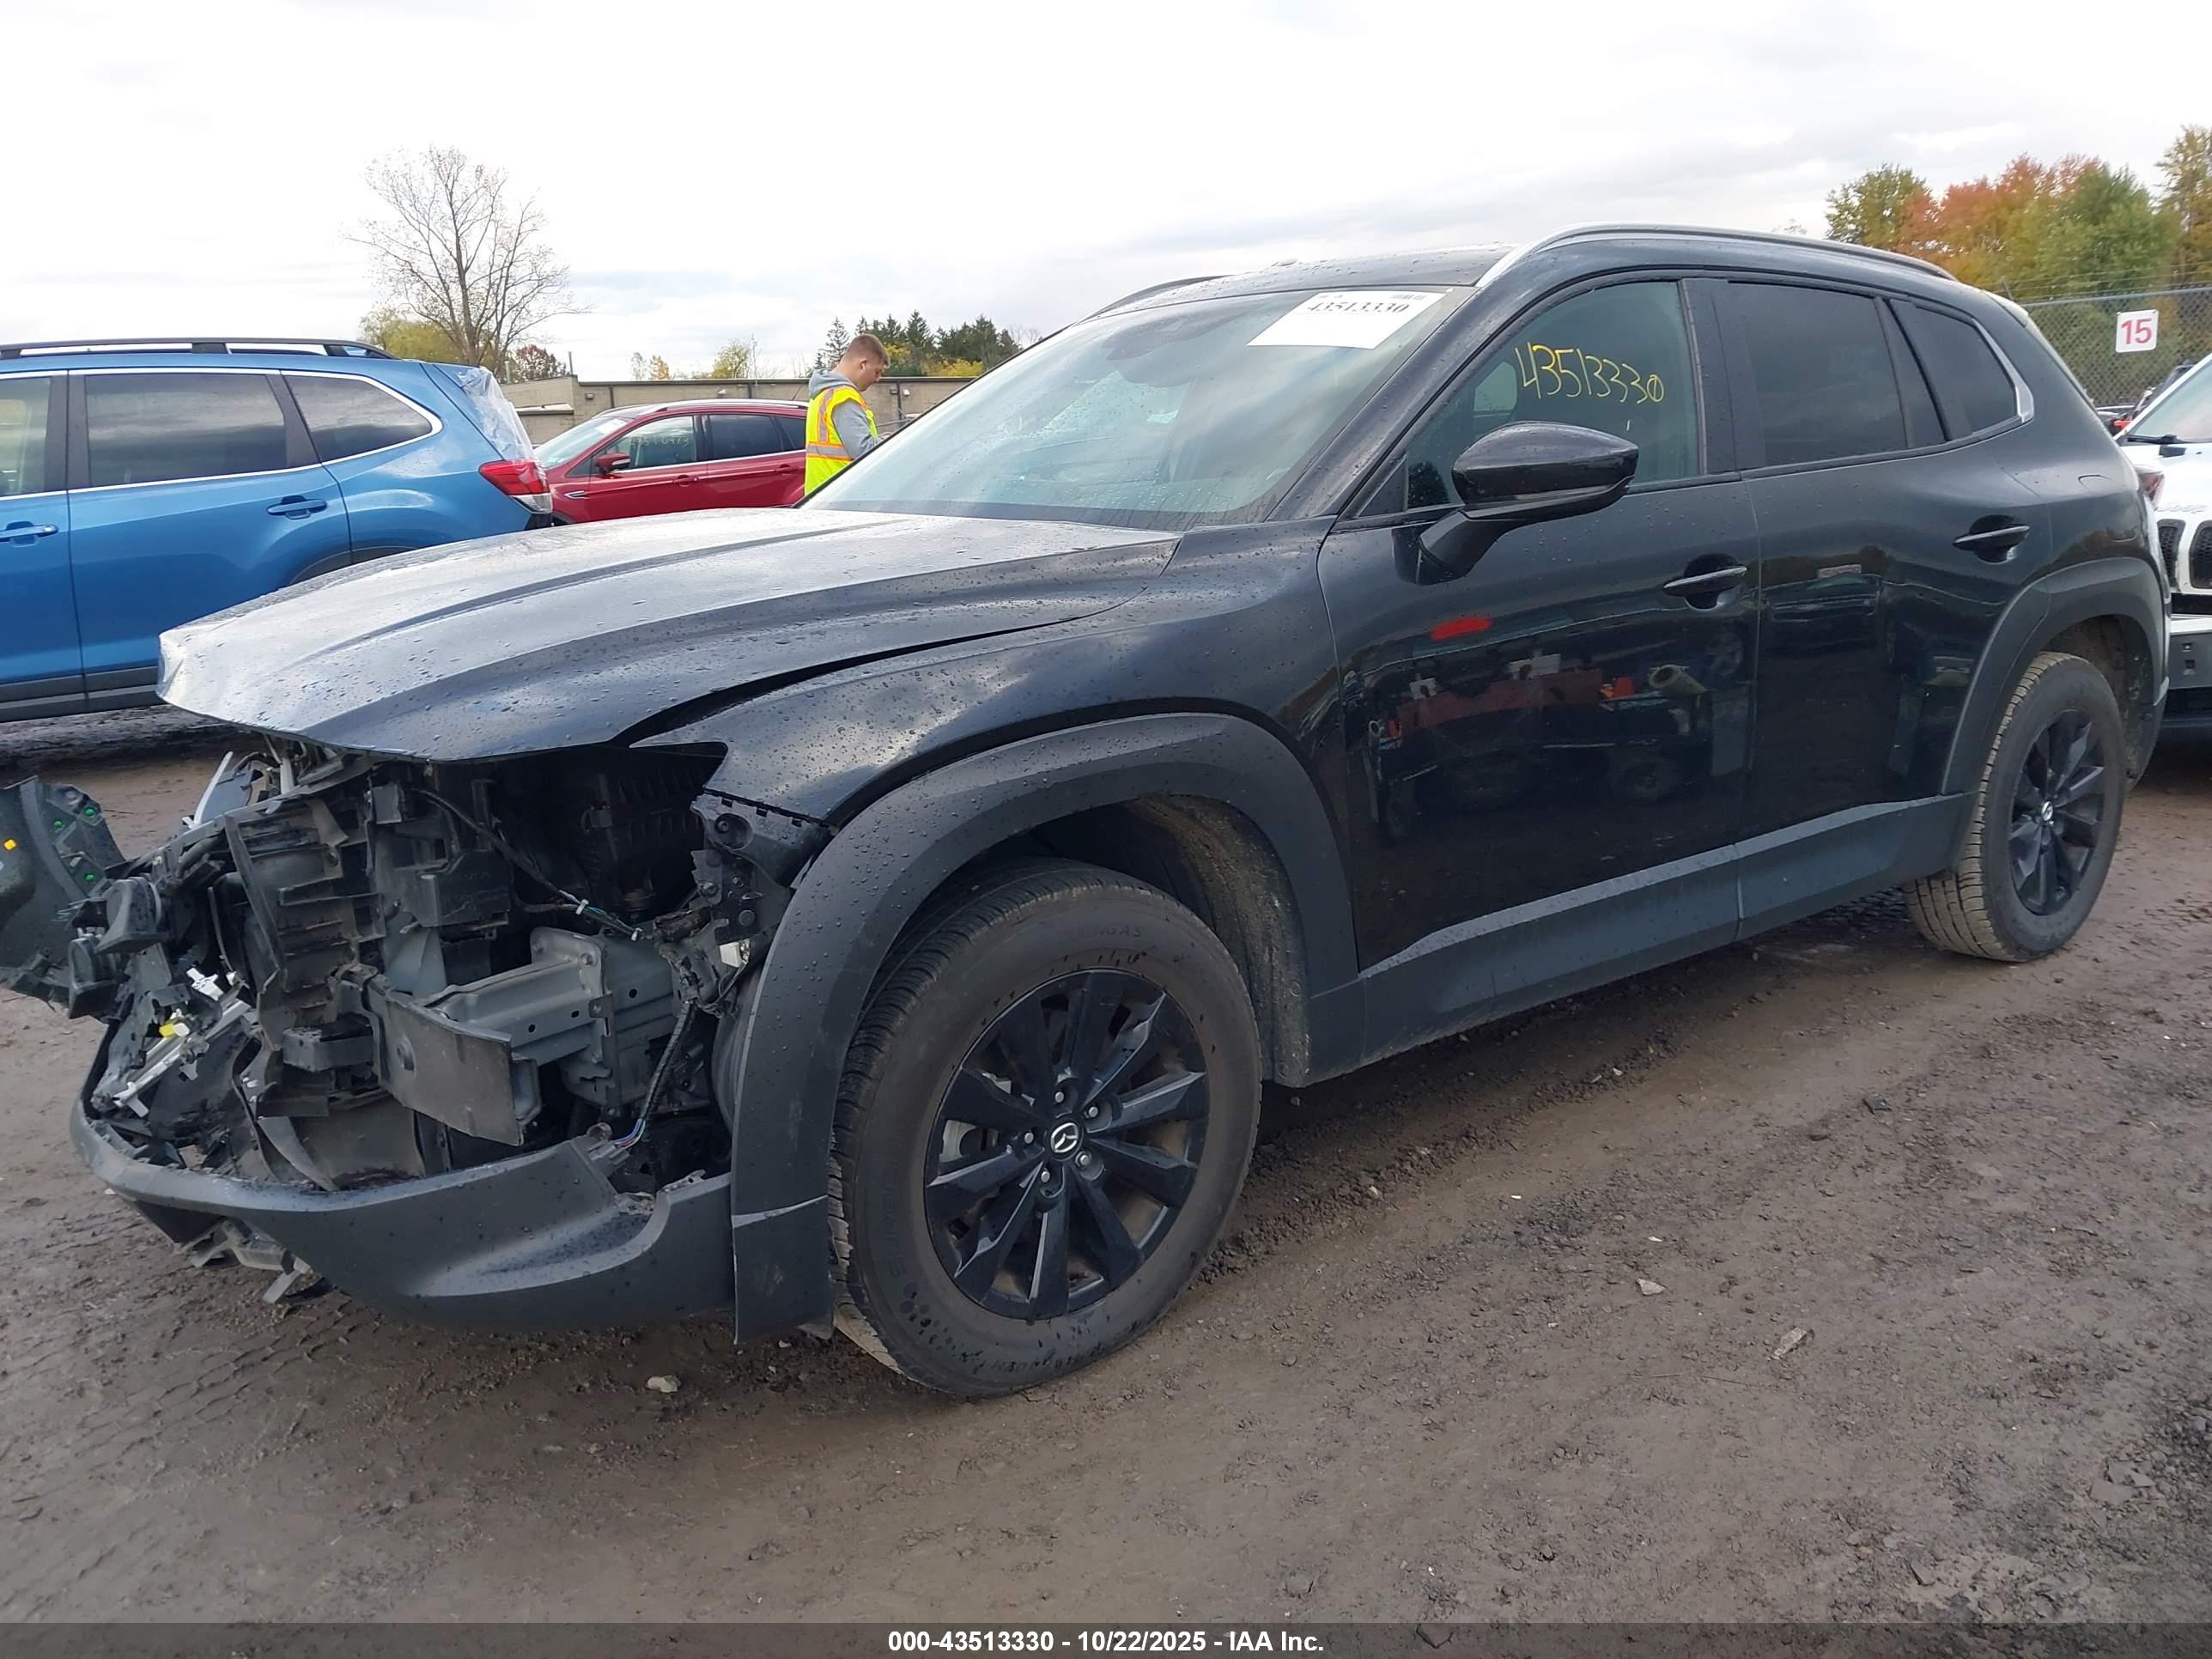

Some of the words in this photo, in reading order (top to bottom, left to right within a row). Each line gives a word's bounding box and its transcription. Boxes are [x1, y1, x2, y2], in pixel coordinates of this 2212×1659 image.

[1307, 302, 1410, 313] 43513330
[2121, 319, 2153, 345] 15
[1515, 343, 1665, 404] 43513330
